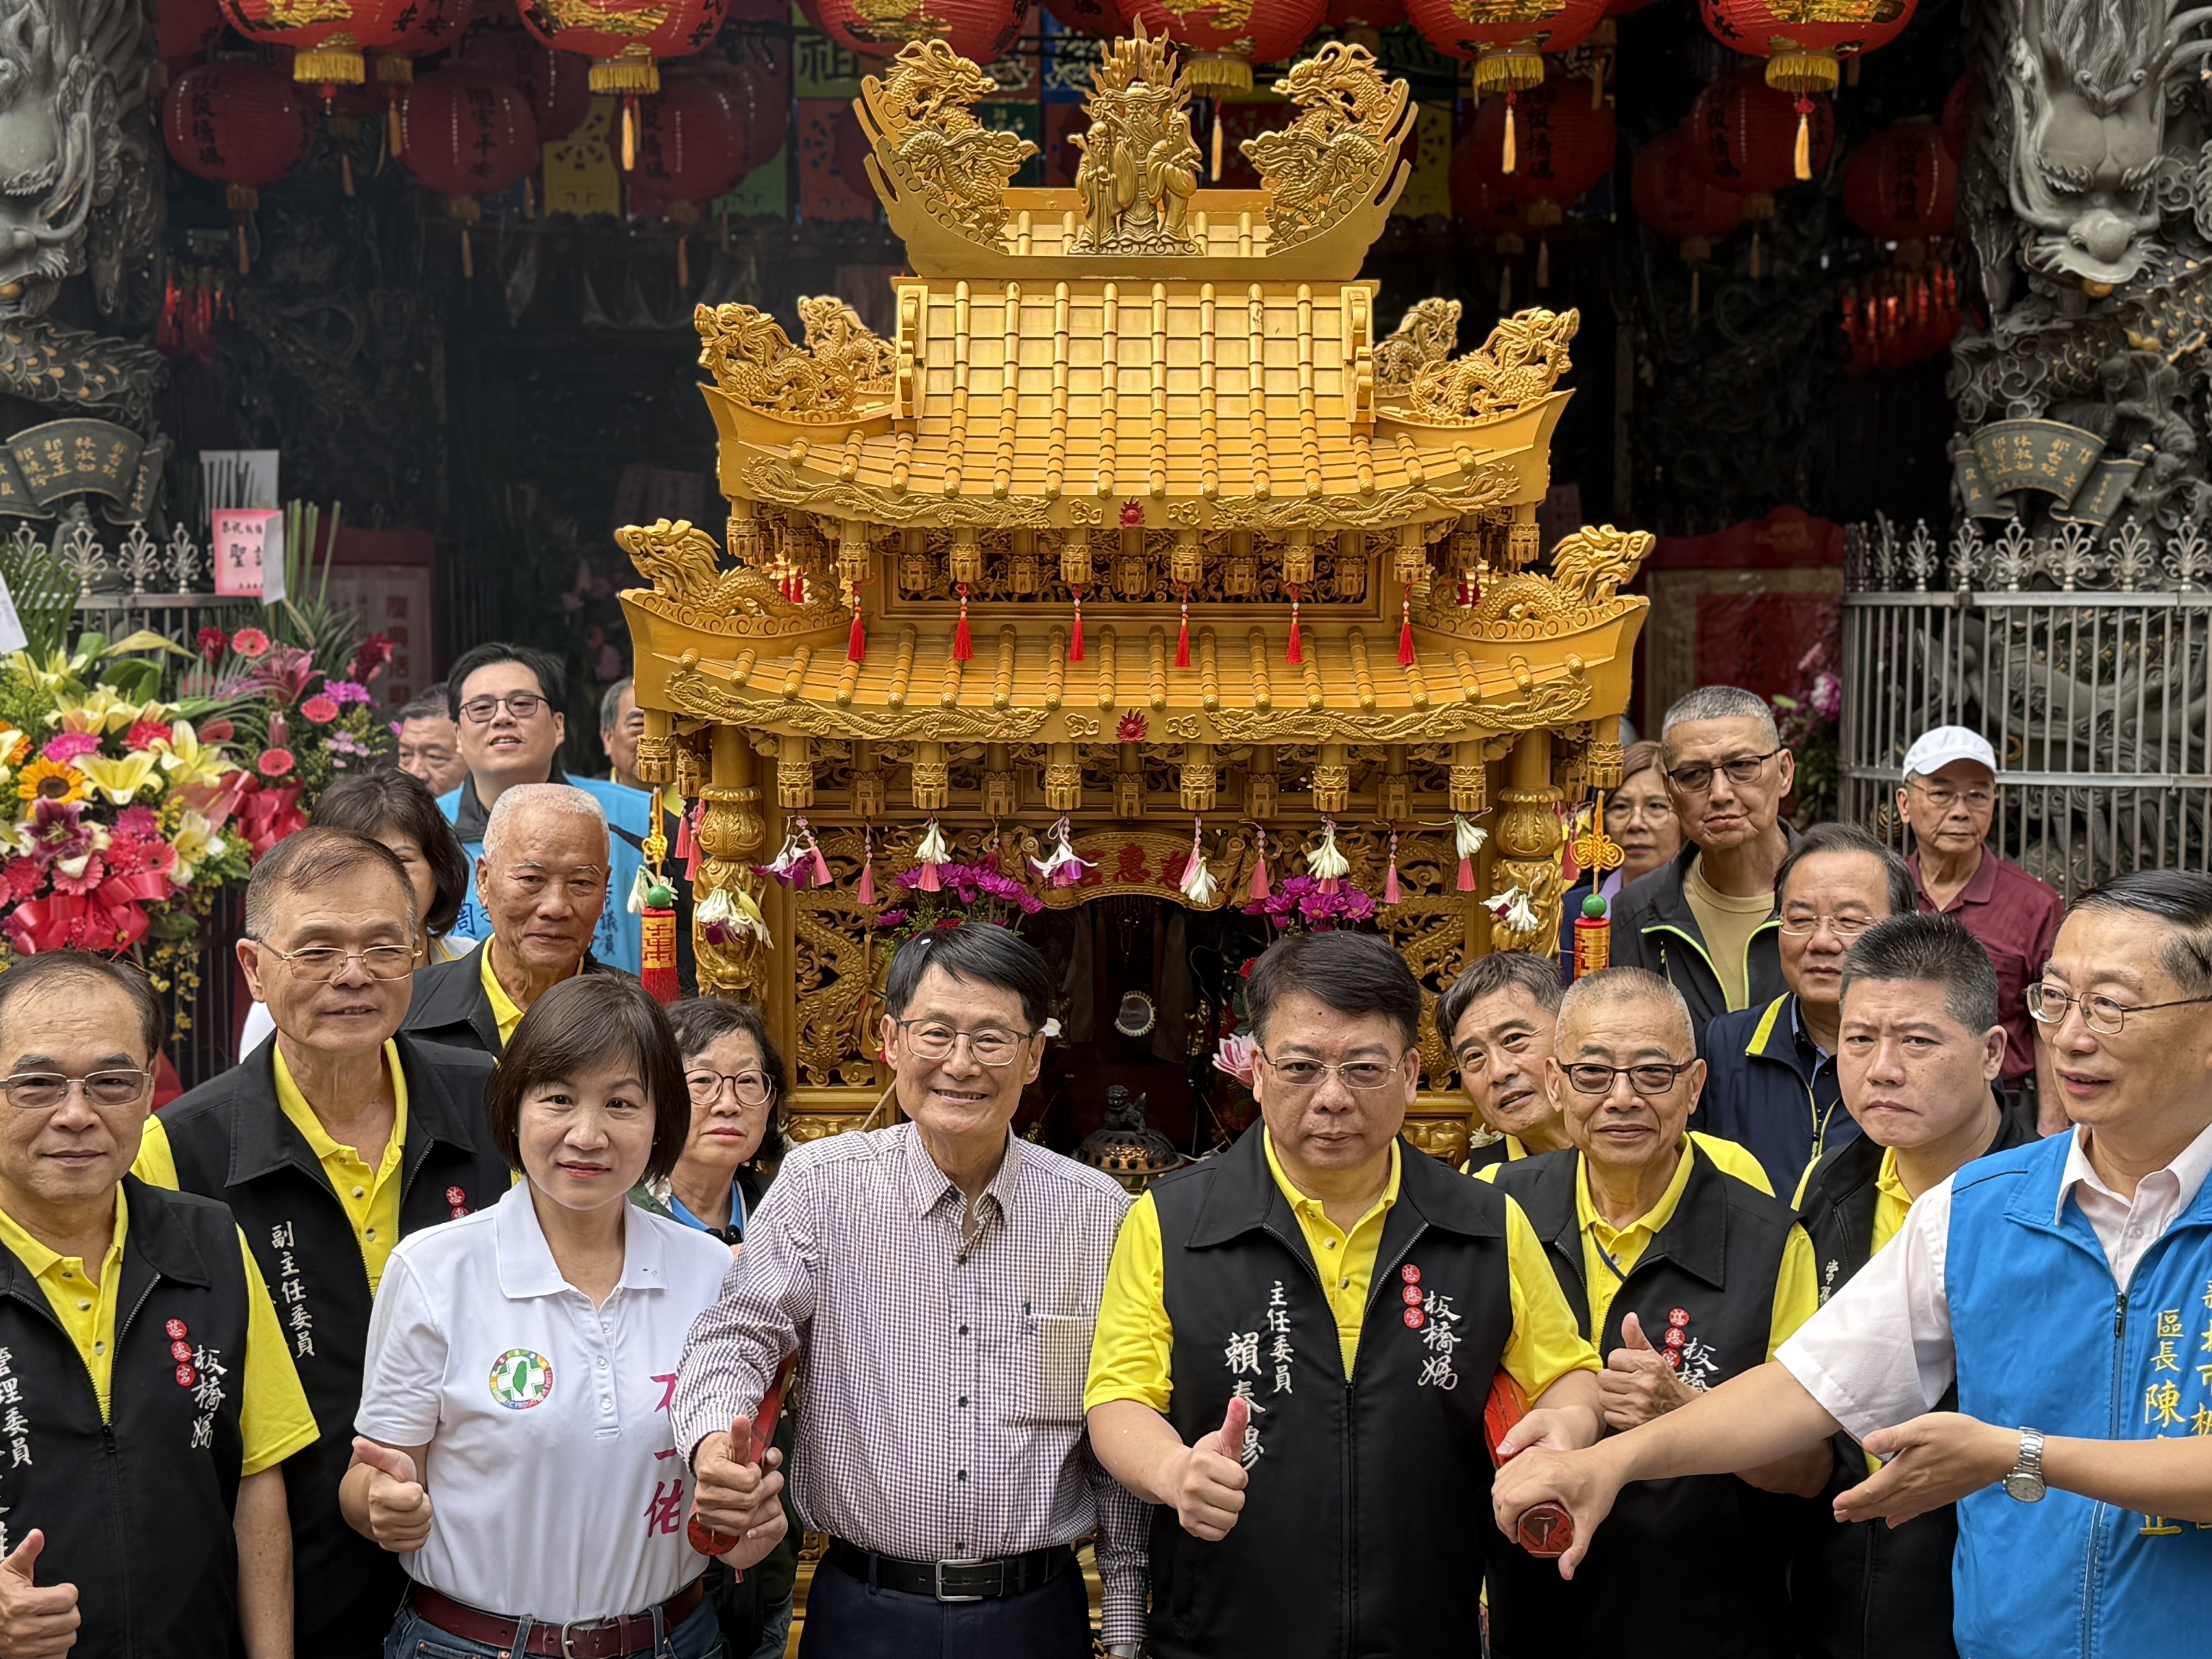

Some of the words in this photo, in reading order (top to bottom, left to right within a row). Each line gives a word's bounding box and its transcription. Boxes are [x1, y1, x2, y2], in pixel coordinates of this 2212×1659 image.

[271, 1221, 315, 1358] 副主任委員
[1267, 1280, 1294, 1394] 主任委員
[1417, 1290, 1462, 1390] 板橋媽
[192, 1344, 228, 1448] 板橋媽
